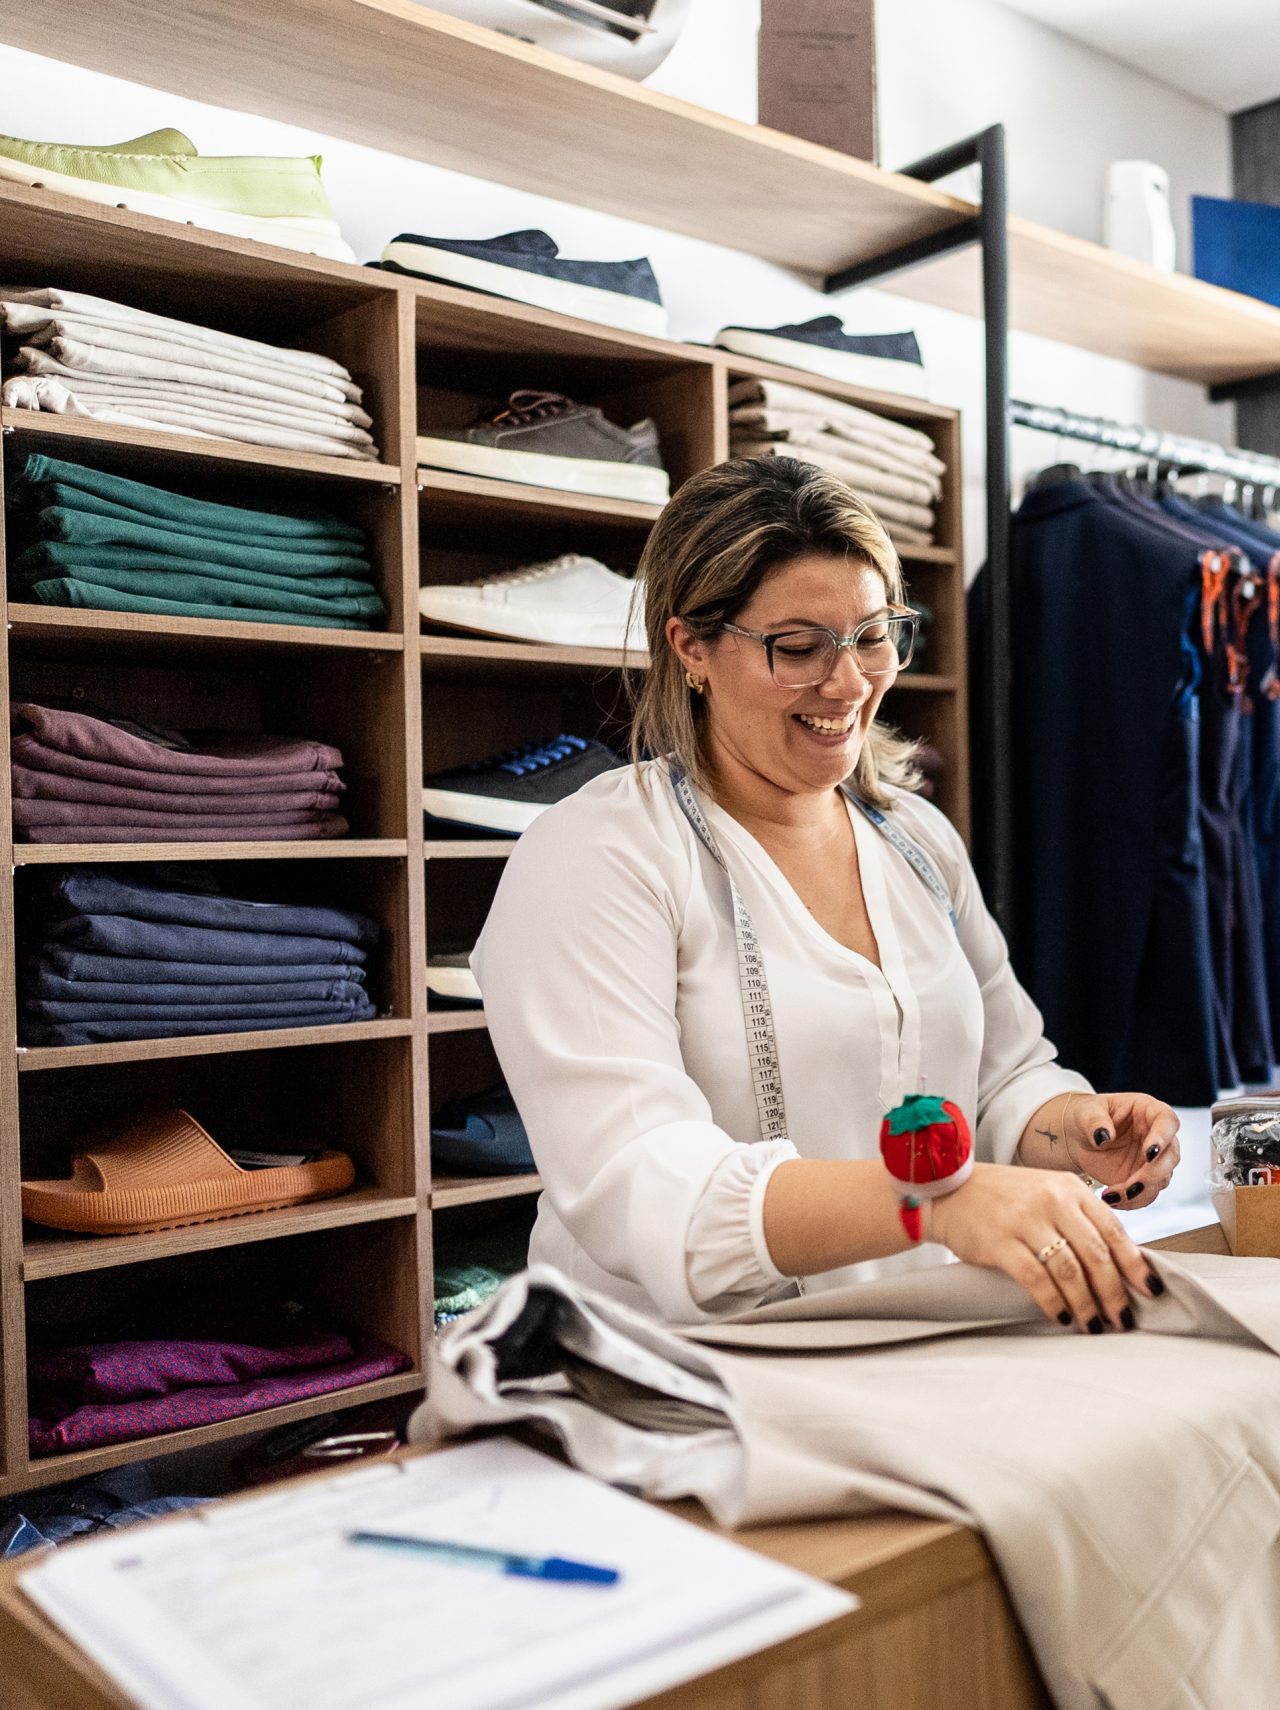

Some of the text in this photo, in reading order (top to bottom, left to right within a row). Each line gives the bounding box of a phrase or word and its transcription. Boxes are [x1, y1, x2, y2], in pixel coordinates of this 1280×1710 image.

[741, 930, 752, 939] 106
[743, 942, 754, 951] 107
[744, 954, 757, 963] 108
[746, 967, 759, 975] 109
[747, 979, 761, 988] 110
[749, 992, 762, 1000] 111
[750, 1004, 764, 1013] 112
[752, 1016, 766, 1026] 113
[753, 1030, 767, 1040] 114
[755, 1043, 769, 1053] 115
[757, 1056, 771, 1066] 116
[759, 1069, 773, 1079] 117
[761, 1082, 775, 1092] 118
[763, 1095, 777, 1105] 119
[765, 1108, 779, 1118] 120
[767, 1121, 780, 1131] 121
